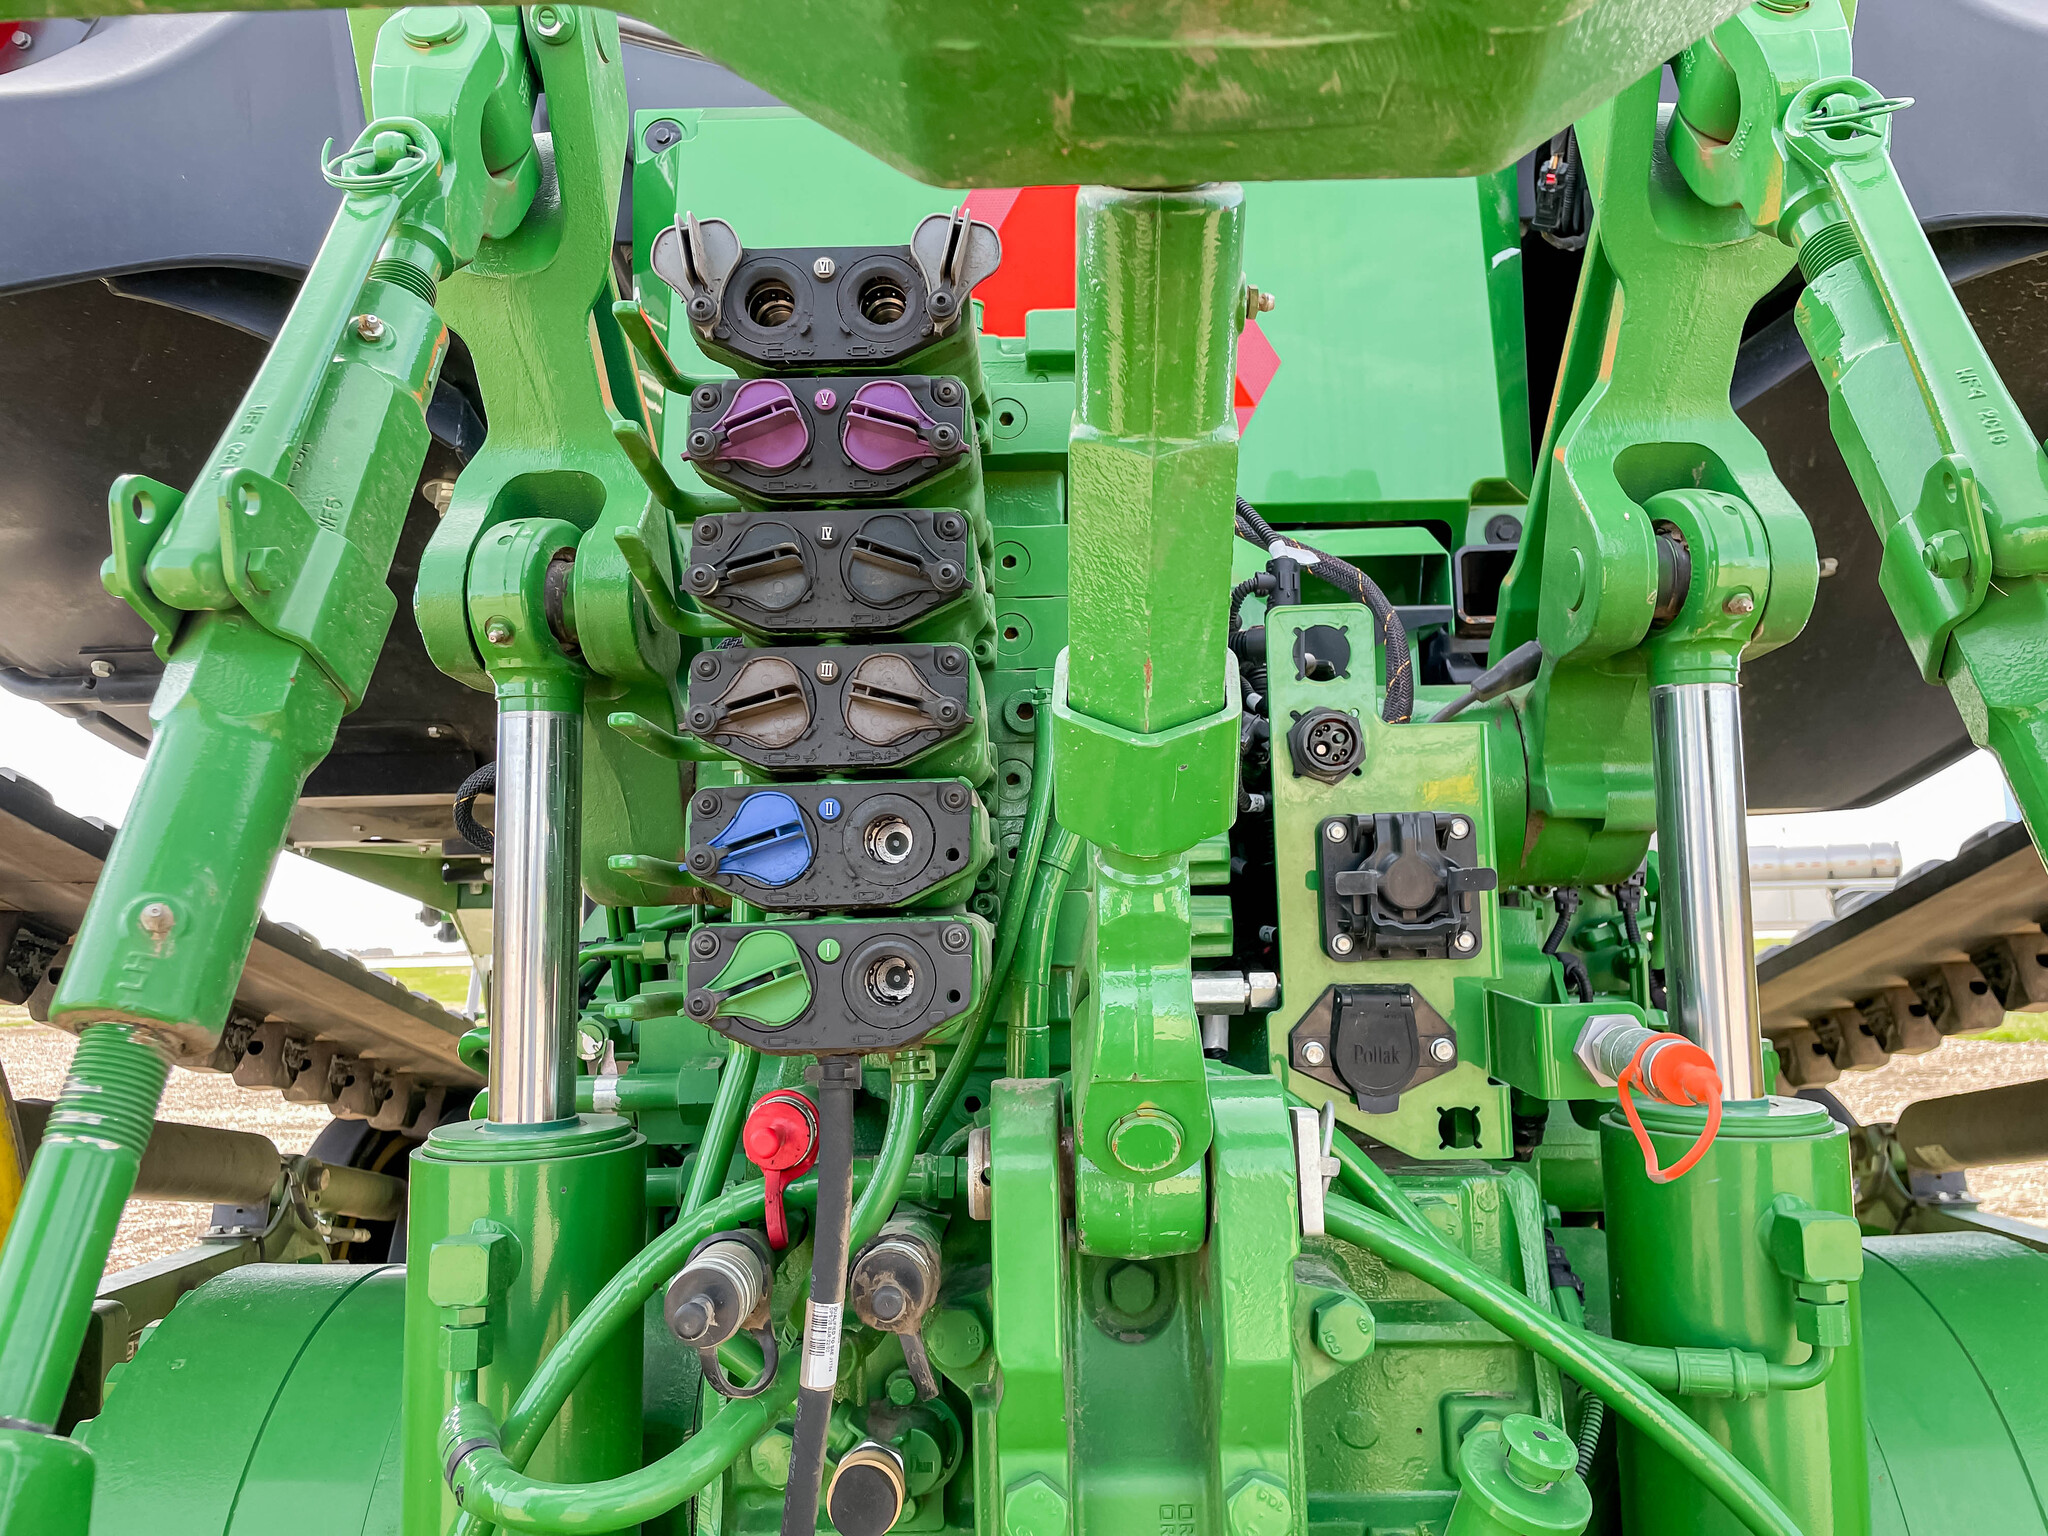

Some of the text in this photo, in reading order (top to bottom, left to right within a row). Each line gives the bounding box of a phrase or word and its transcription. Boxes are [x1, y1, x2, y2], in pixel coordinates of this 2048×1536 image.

[818, 260, 830, 275] VI
[820, 391, 830, 406] V
[821, 526, 833, 541] IV
[821, 663, 833, 678] III
[825, 802, 834, 817] II
[1353, 1044, 1400, 1065] Pollak
